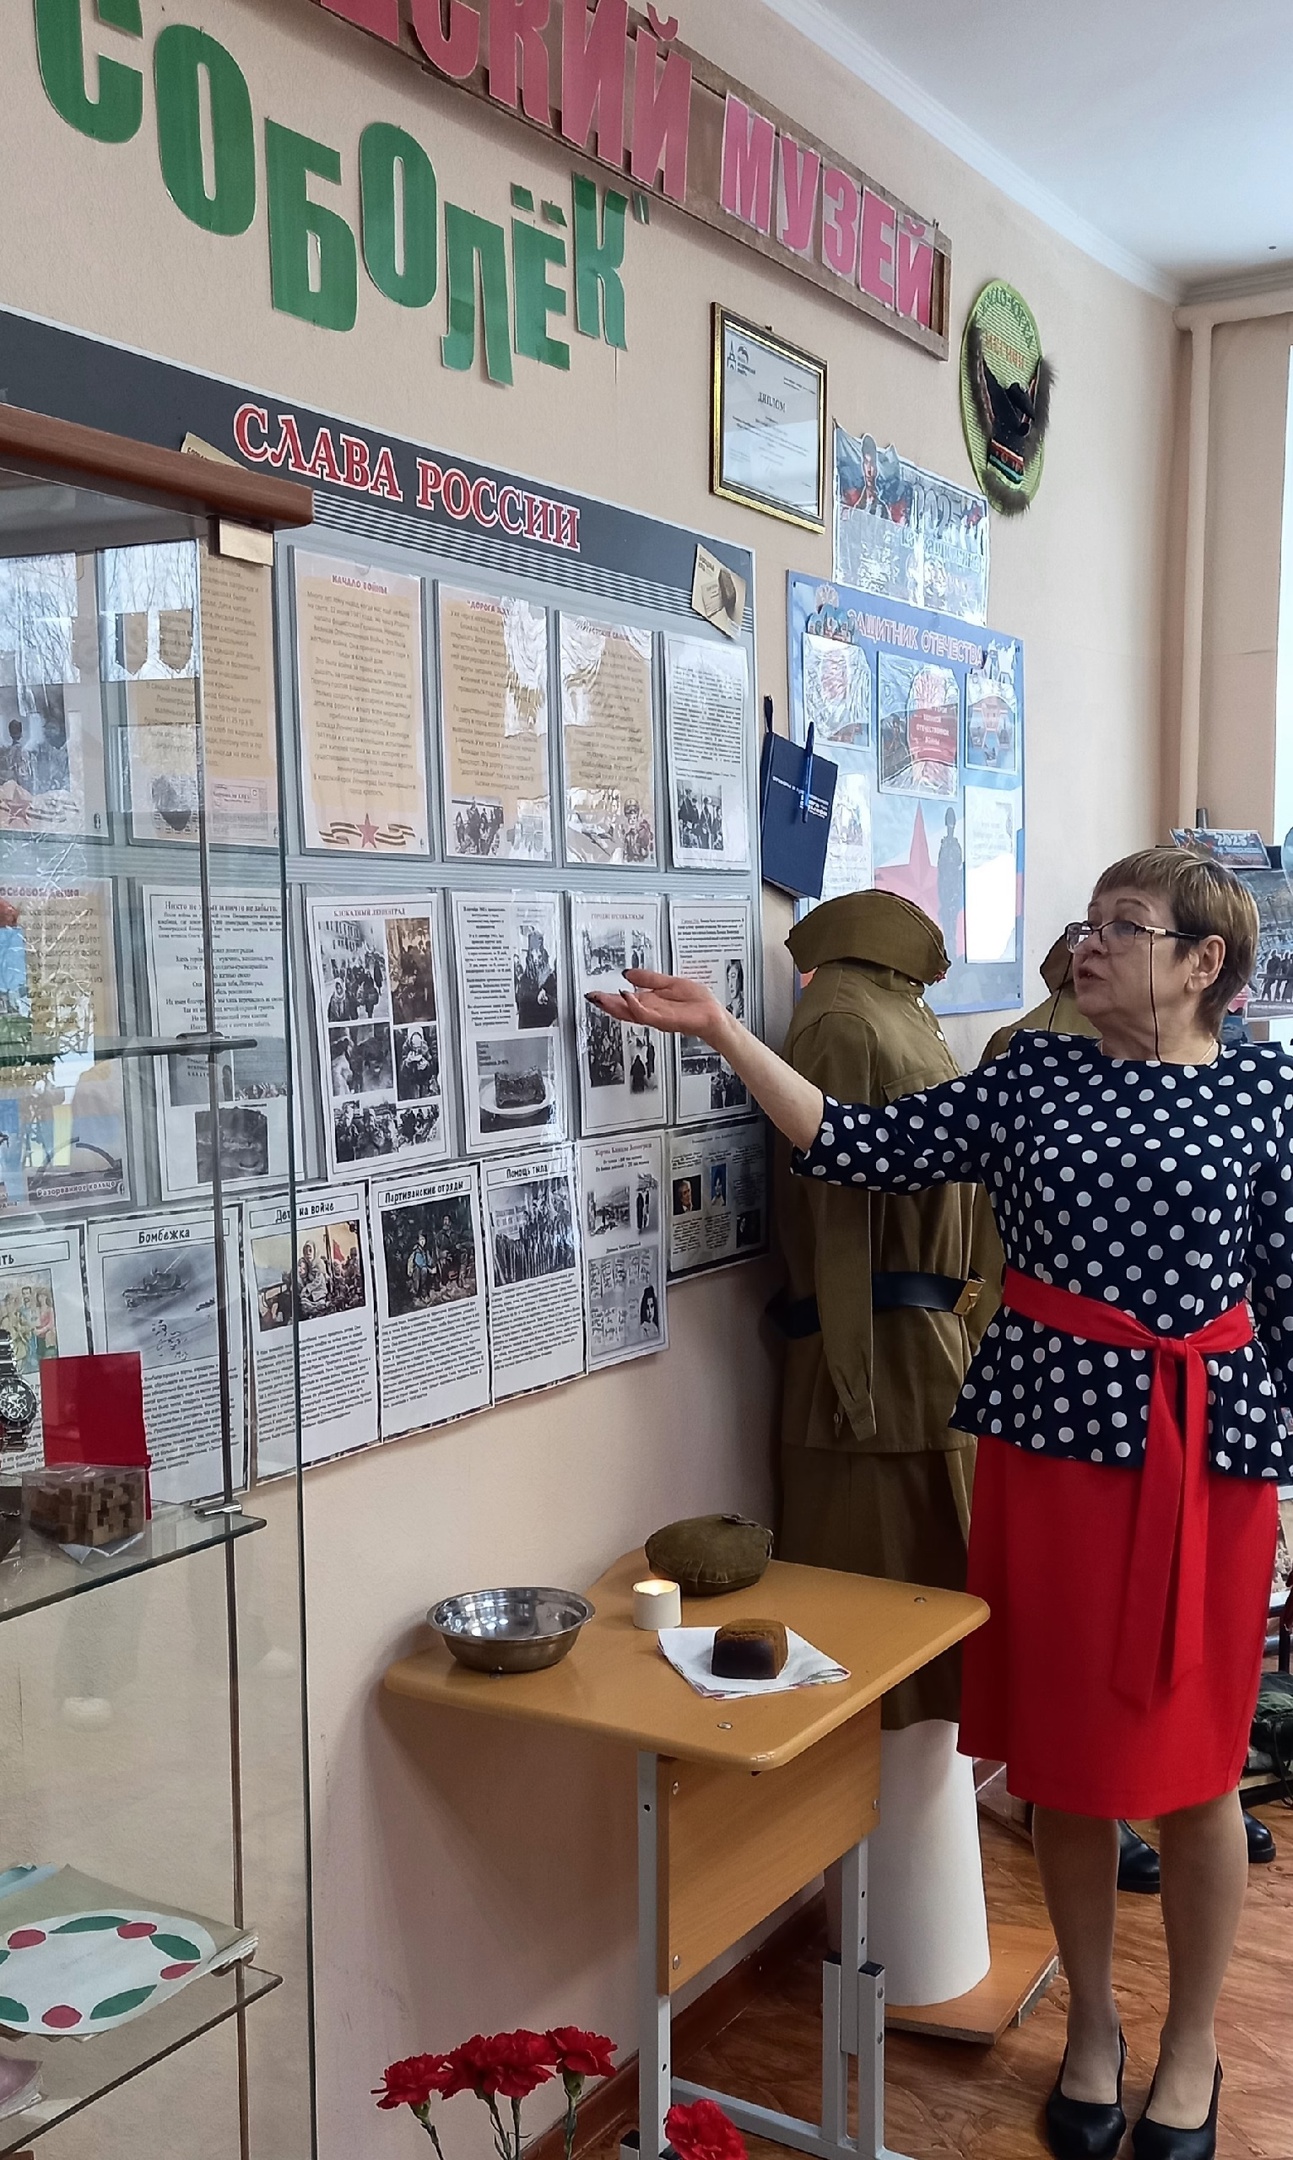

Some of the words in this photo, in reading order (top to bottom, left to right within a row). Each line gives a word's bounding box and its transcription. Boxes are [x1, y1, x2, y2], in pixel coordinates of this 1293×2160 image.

[320, 0, 692, 201] КИЙ
[718, 92, 935, 328] МУЗЕЙ
[233, 403, 404, 502] СЛАВА
[416, 456, 581, 552] РОССИИ
[331, 574, 361, 589] НАЧАЛО
[921, 629, 984, 667] ОТЕЧЕСТВА
[506, 1167, 531, 1179] Помощь
[385, 1186, 436, 1204] Партизанские
[437, 1181, 464, 1194] отряды
[275, 1209, 294, 1224] Дет
[299, 1206, 309, 1216] на
[310, 1202, 335, 1215] войне
[138, 1228, 190, 1245] Бомбежка
